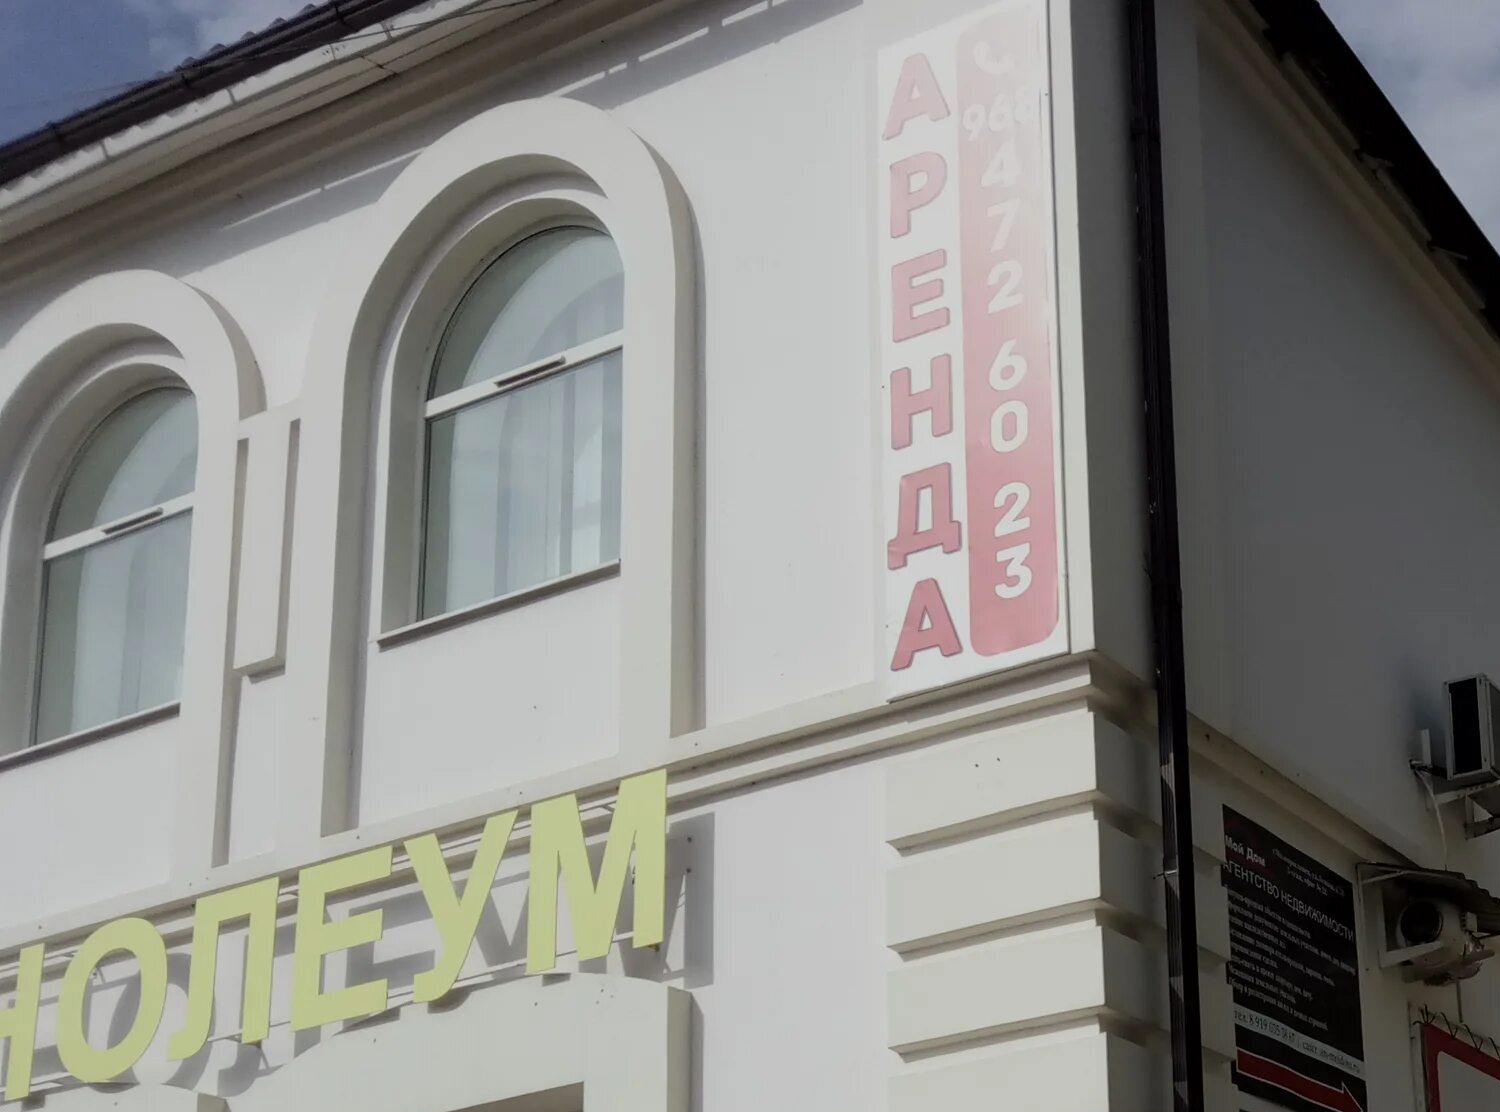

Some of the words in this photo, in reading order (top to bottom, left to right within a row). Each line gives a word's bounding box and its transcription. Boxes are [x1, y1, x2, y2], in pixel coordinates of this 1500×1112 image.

[980, 138, 1026, 315] 472
[881, 52, 963, 671] АРЕНДА
[988, 339, 1028, 454] 60
[993, 481, 1033, 600] 23
[1222, 860, 1280, 899] АГЕНТСТВО
[1280, 890, 1354, 943] НЕДВИЖИМОСТИ
[1246, 847, 1266, 867] Дом
